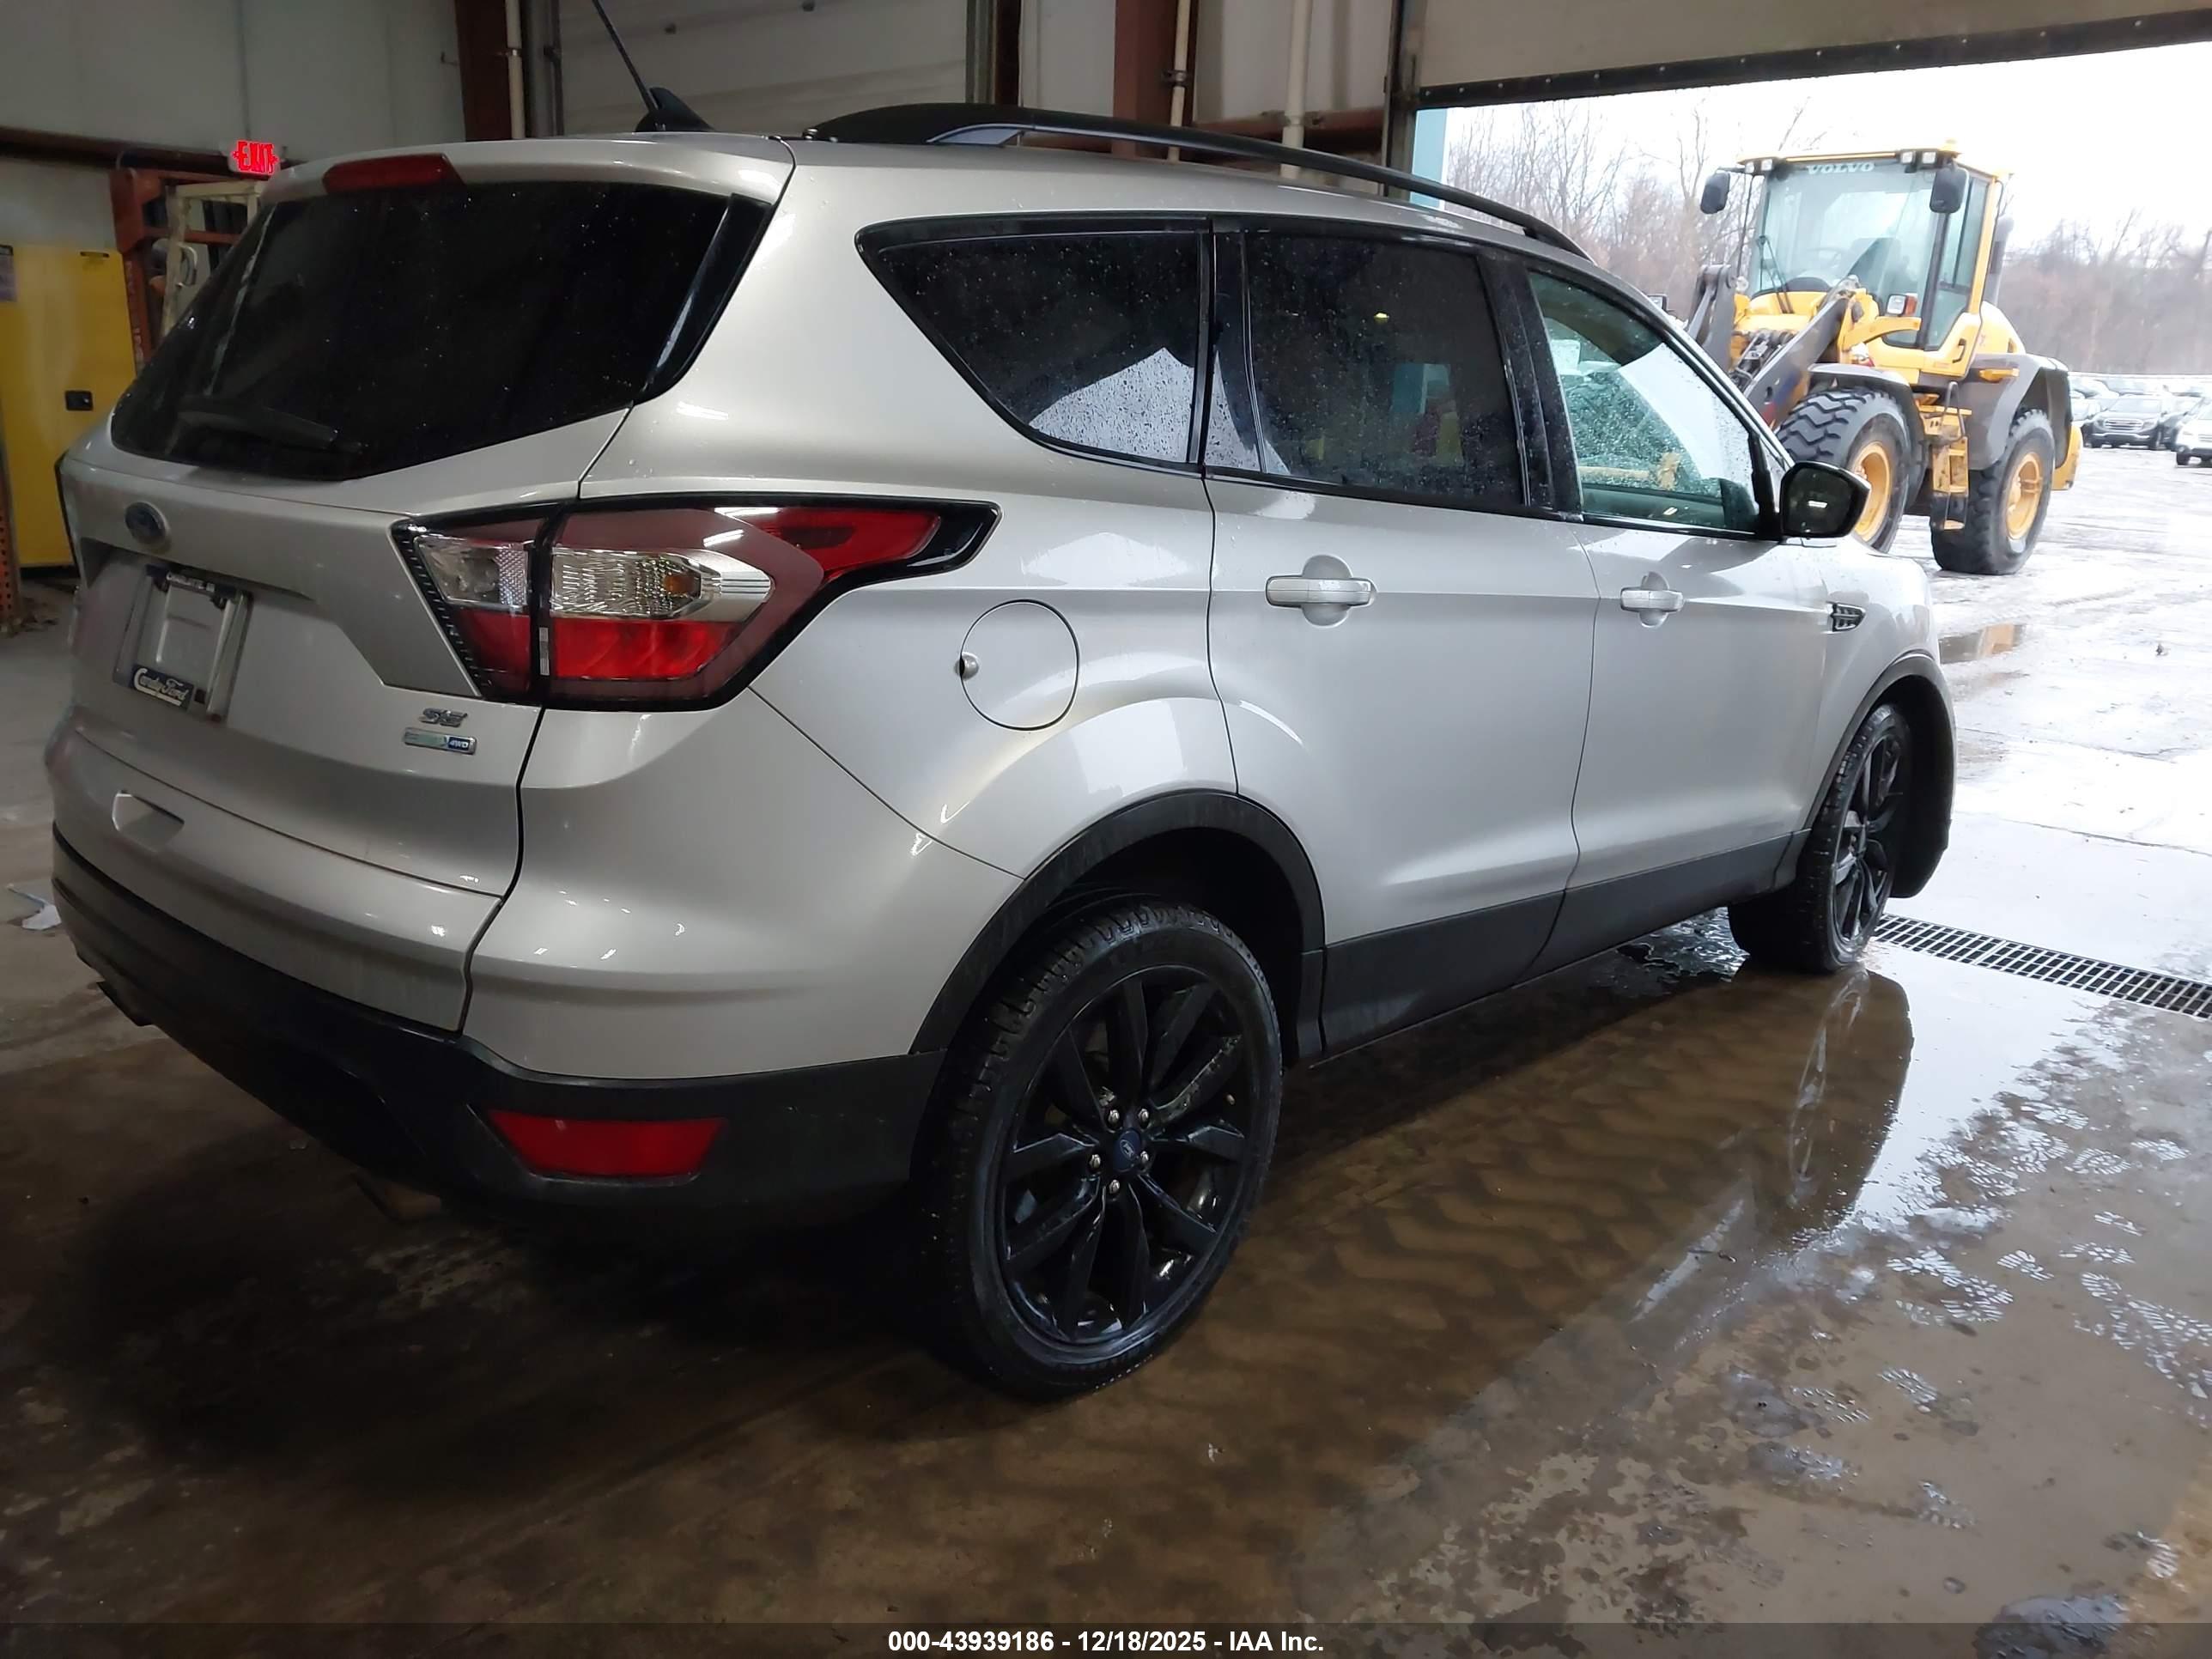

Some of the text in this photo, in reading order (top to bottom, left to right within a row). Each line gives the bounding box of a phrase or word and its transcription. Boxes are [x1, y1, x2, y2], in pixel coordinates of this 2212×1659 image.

[236, 141, 274, 175] EXIT
[1807, 161, 1875, 174] VOLVO
[418, 708, 468, 728] SE
